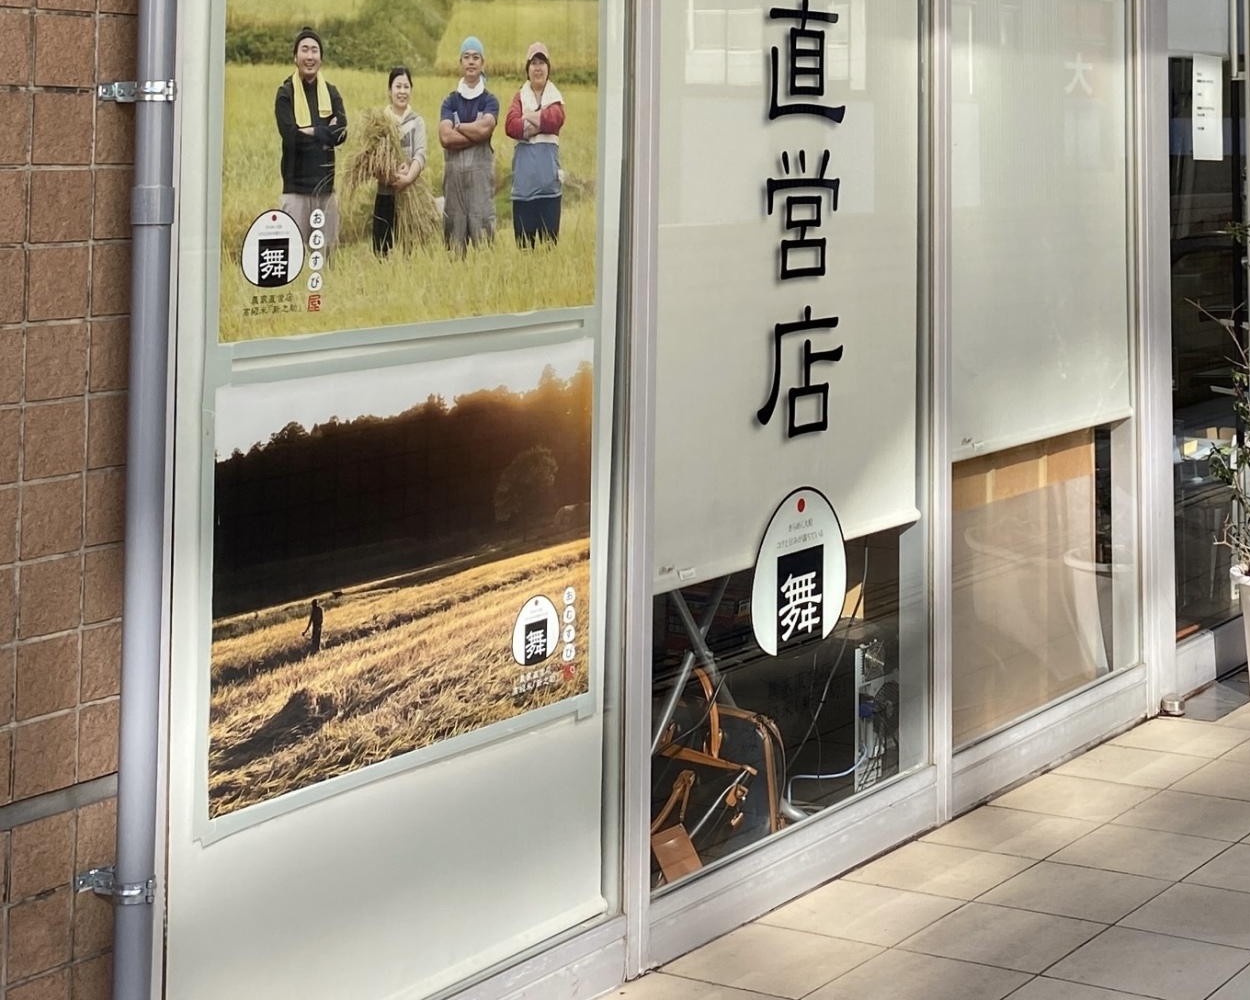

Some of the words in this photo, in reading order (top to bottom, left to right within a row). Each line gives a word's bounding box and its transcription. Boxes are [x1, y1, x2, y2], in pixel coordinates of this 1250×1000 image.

[259, 248, 288, 280] 舞
[778, 571, 823, 641] 舞
[525, 629, 547, 659] 舞
